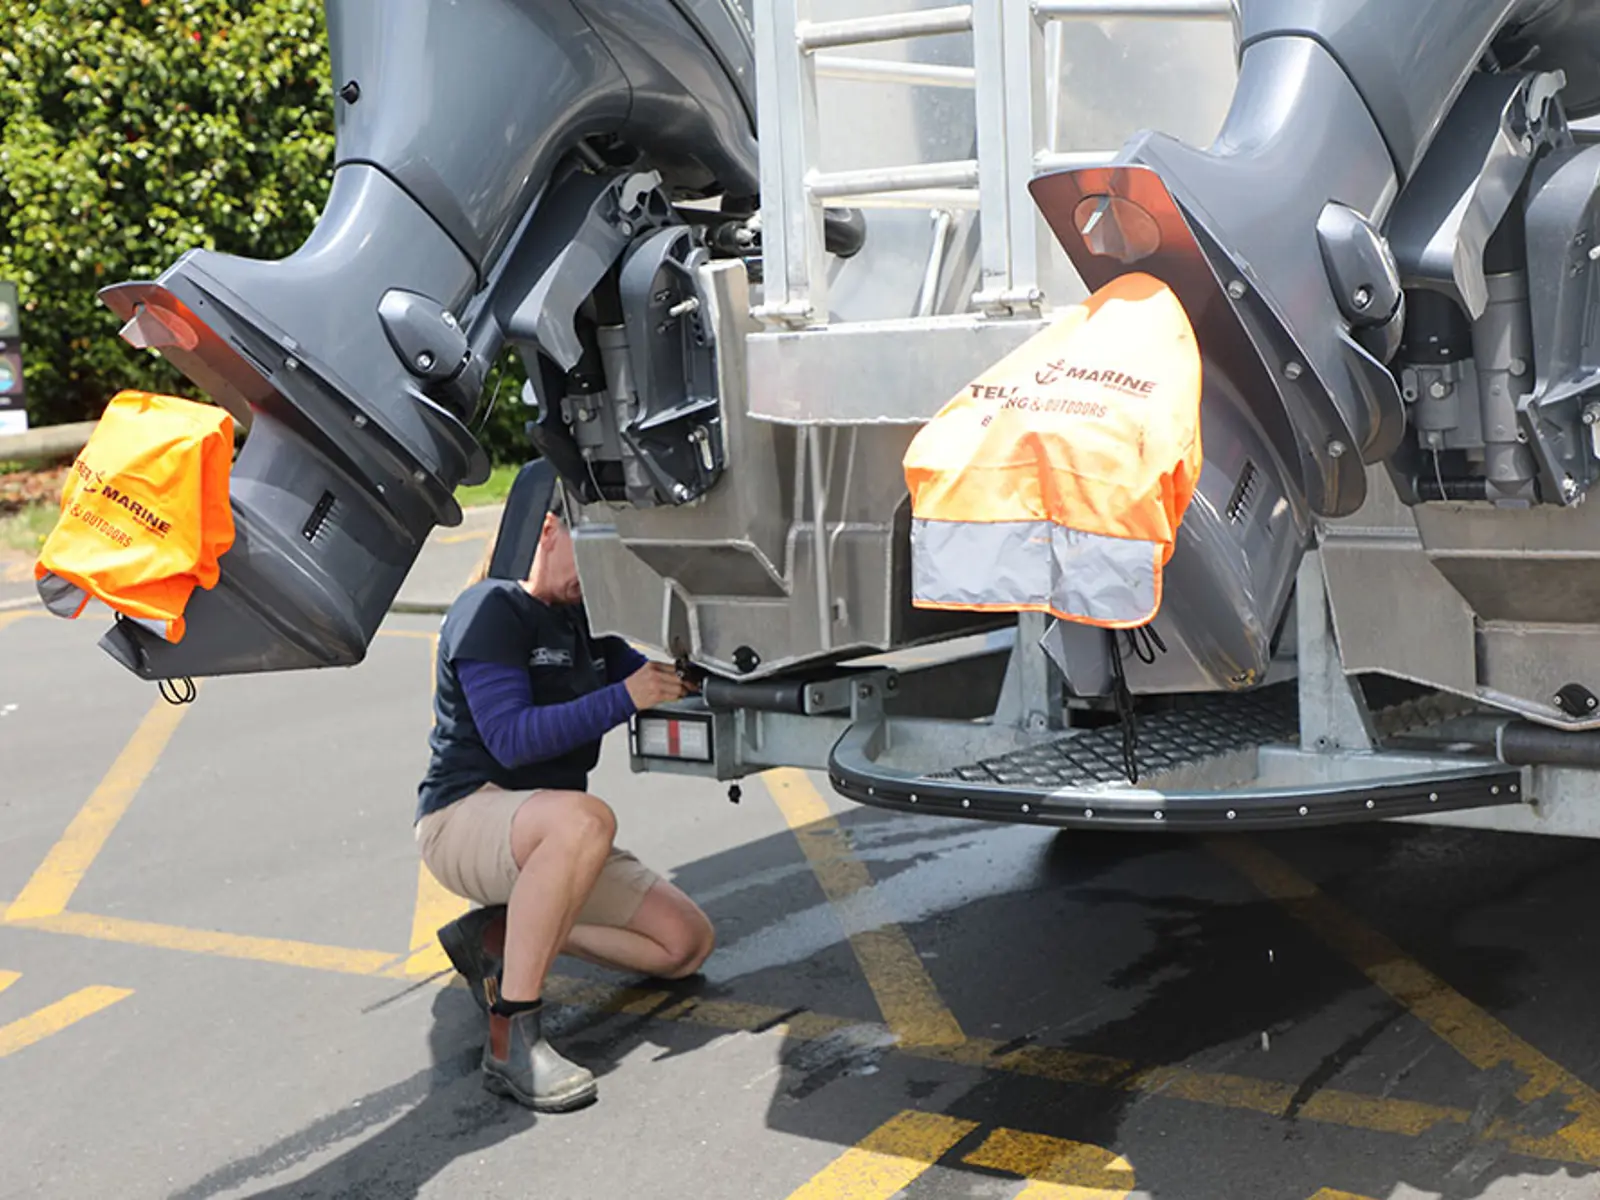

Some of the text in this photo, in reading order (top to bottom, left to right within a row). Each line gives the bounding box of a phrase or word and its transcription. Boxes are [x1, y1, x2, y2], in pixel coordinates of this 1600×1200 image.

[1065, 366, 1157, 393] MARINE
[70, 503, 81, 518] &
[82, 510, 133, 548] OUTDOORS
[102, 485, 172, 534] MARINE
